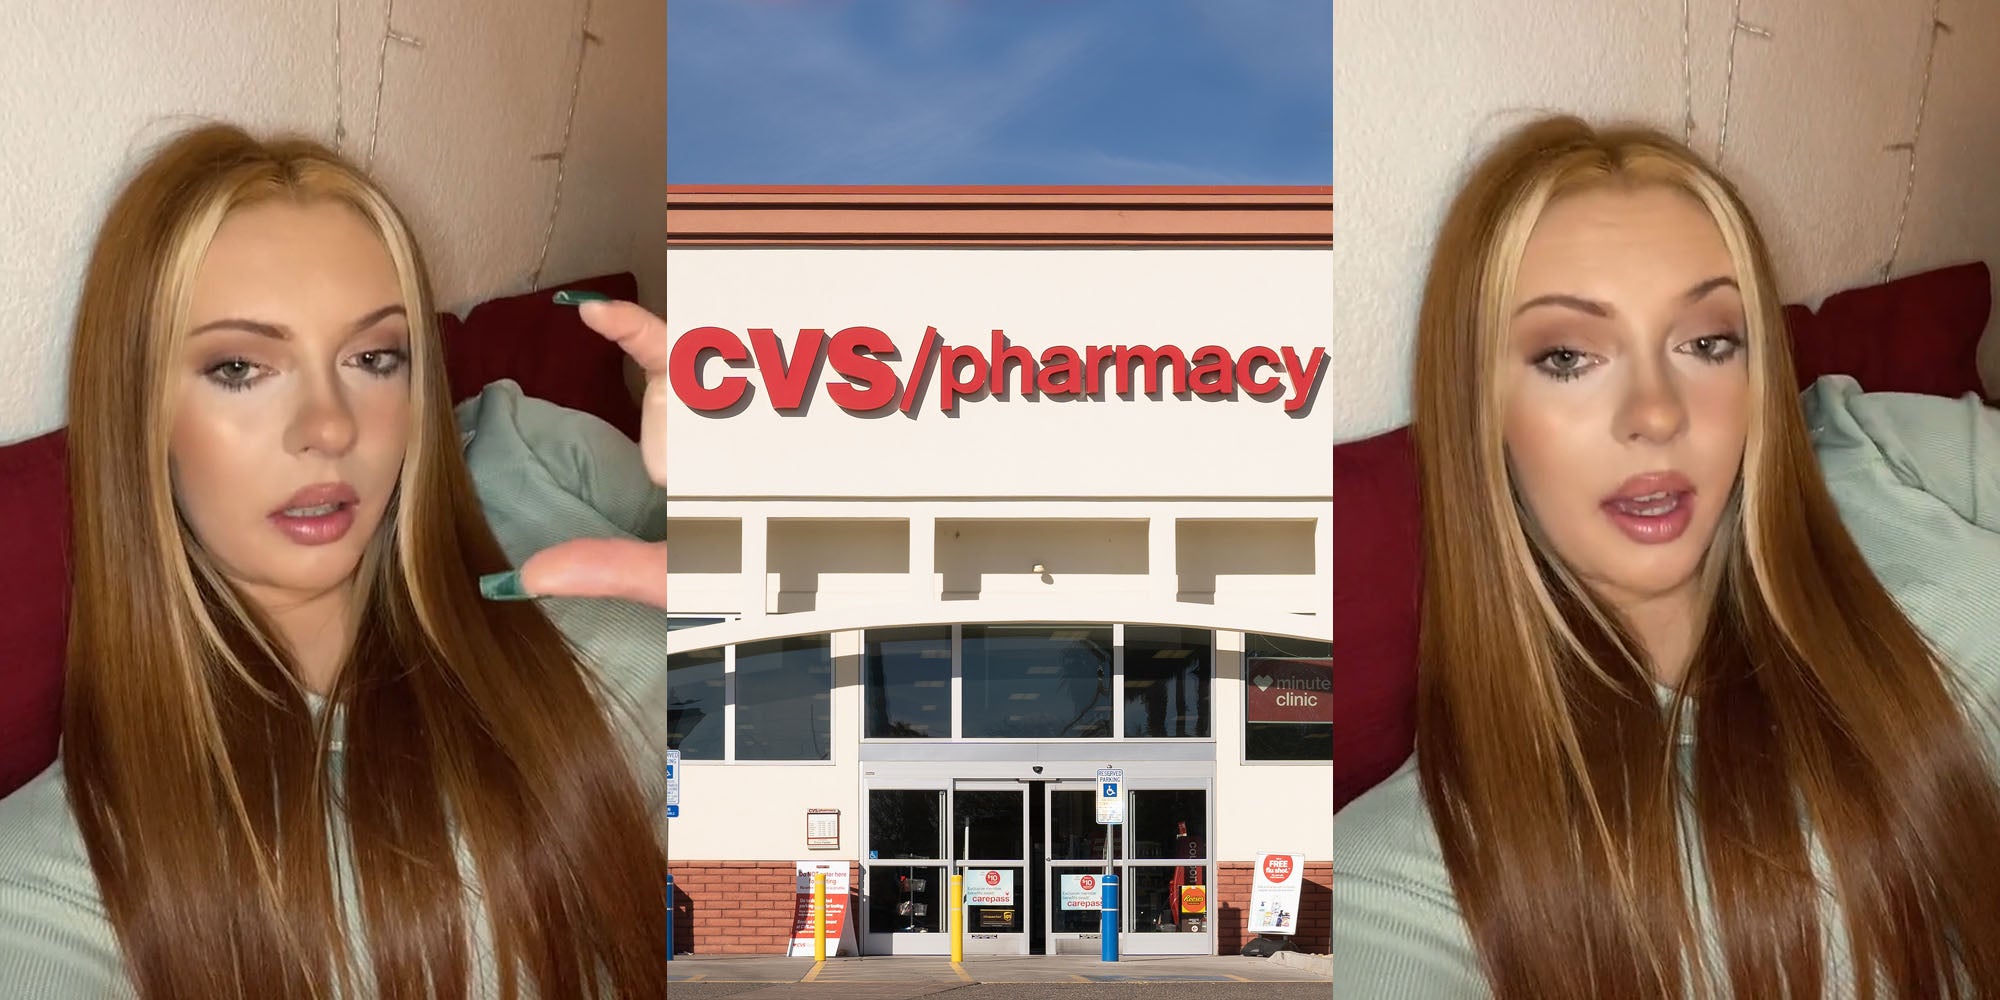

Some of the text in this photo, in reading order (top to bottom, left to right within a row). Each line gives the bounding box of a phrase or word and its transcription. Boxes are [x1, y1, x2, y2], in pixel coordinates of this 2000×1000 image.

[1276, 675, 1332, 690] minute
[1276, 692, 1318, 707] clinic
[1082, 879, 1093, 887] $10
[972, 896, 1010, 904] carepass
